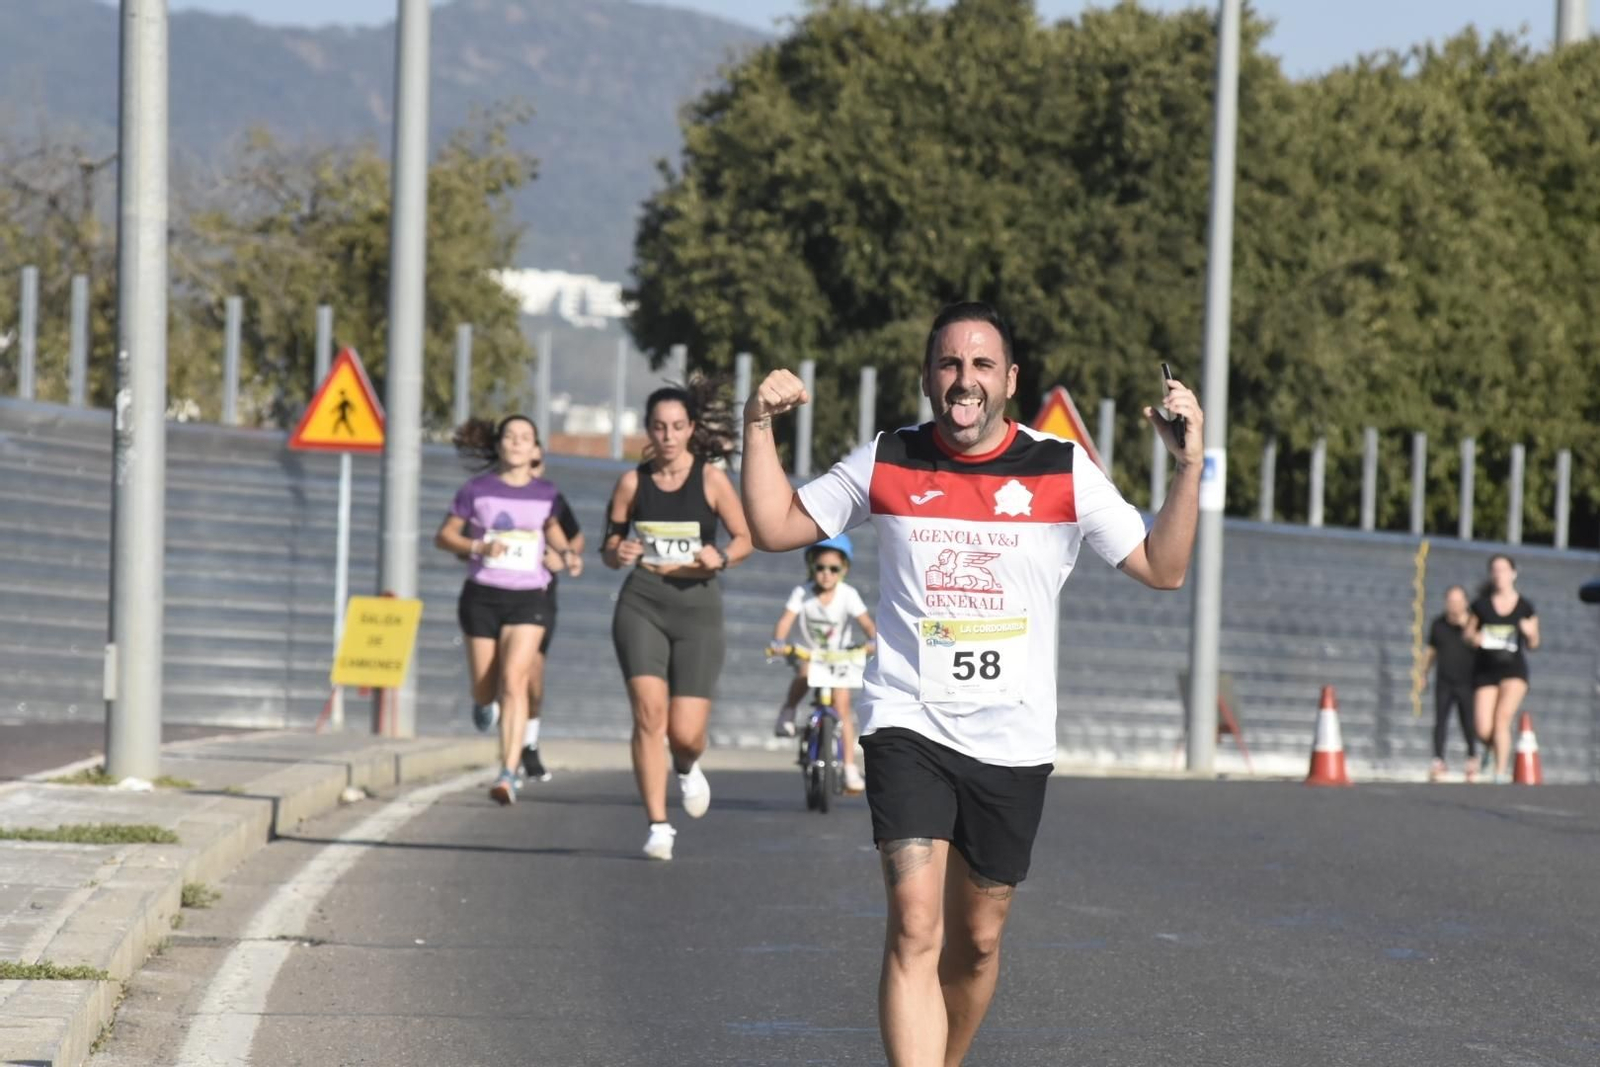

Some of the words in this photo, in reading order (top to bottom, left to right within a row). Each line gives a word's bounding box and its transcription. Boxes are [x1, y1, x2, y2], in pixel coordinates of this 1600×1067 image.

[908, 528, 982, 545] AGENCIA
[988, 532, 1019, 547] V&J
[926, 594, 1004, 611] GENERALI
[952, 650, 1001, 681] 58
